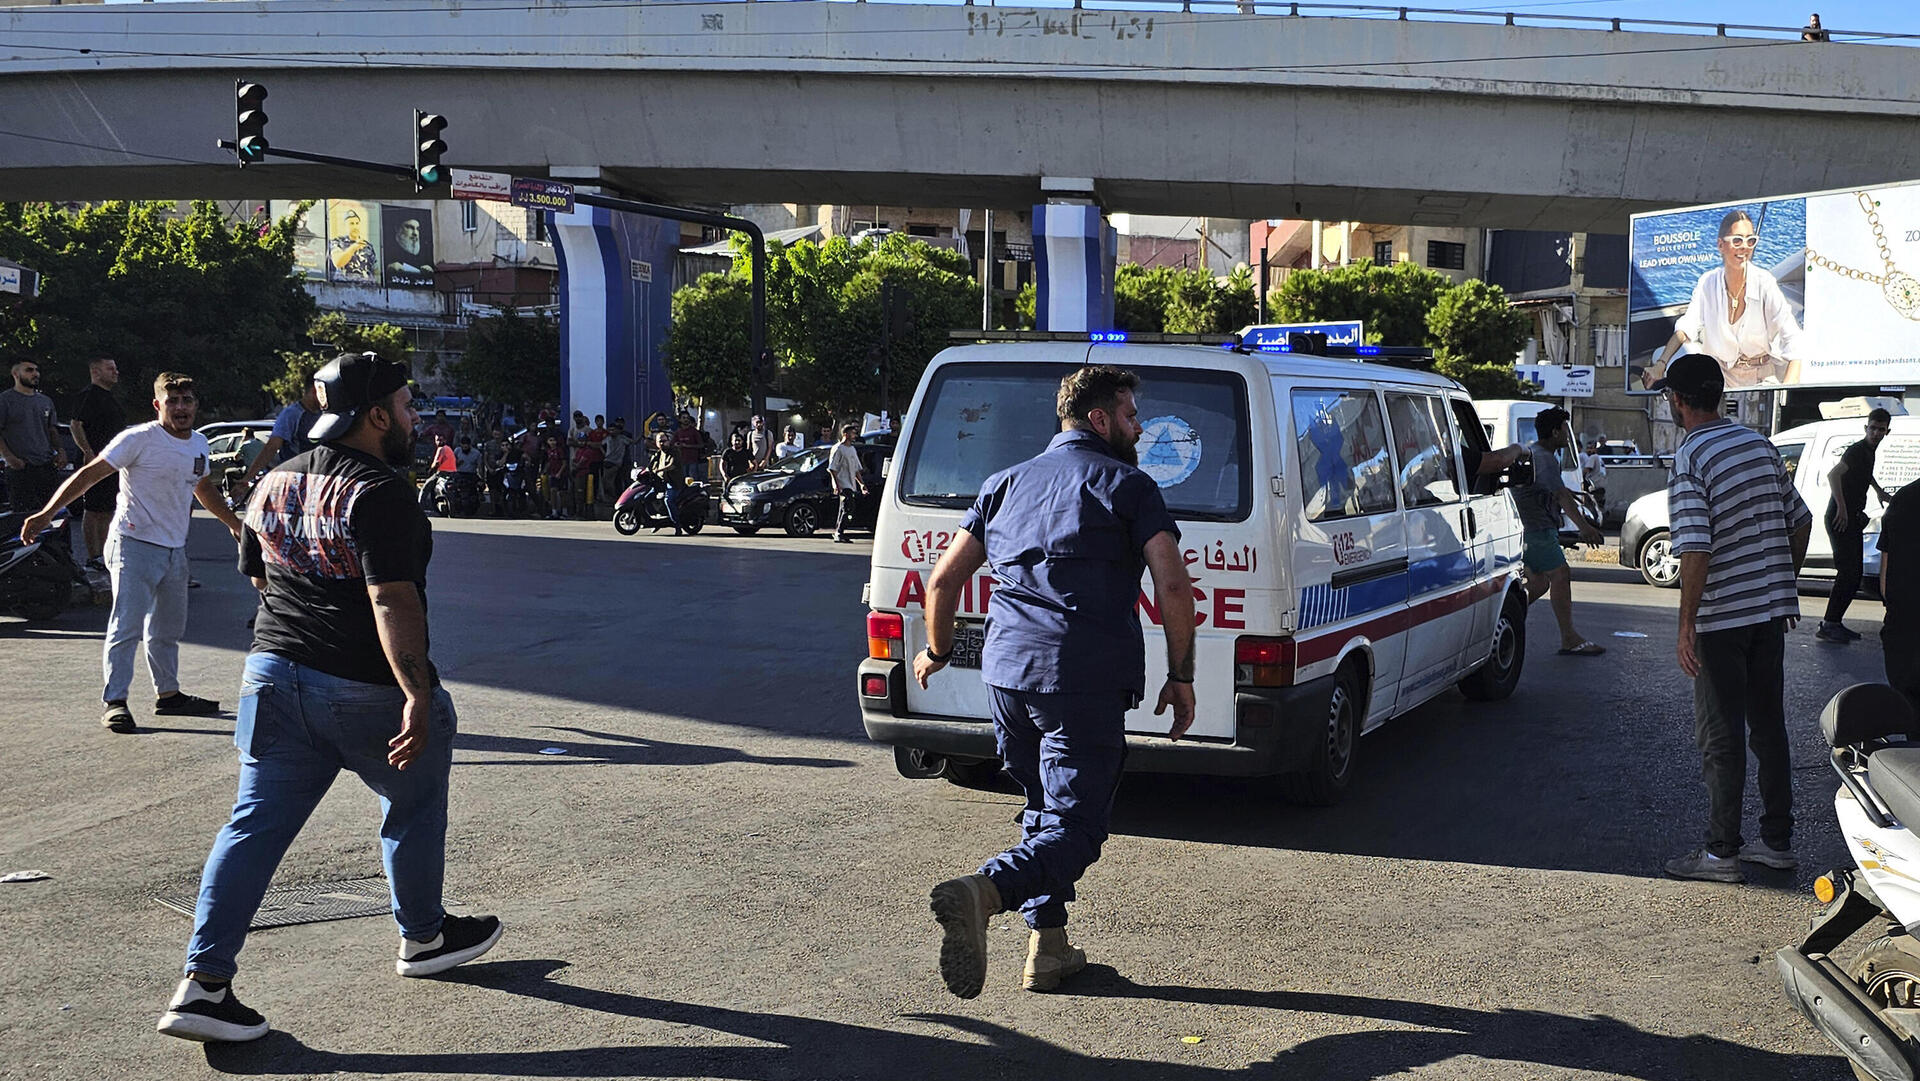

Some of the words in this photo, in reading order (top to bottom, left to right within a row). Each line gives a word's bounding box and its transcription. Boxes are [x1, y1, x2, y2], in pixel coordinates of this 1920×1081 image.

[529, 193, 566, 206] 3.500.000
[1653, 231, 1700, 246] BOUSSOLE
[1657, 243, 1697, 252] COLLECTION
[1640, 259, 1657, 268] LEAD
[1658, 257, 1677, 267] YOUR
[1678, 255, 1697, 265] OWN
[1697, 253, 1714, 263] WAY
[922, 531, 957, 550] 12
[1340, 532, 1355, 551] 125
